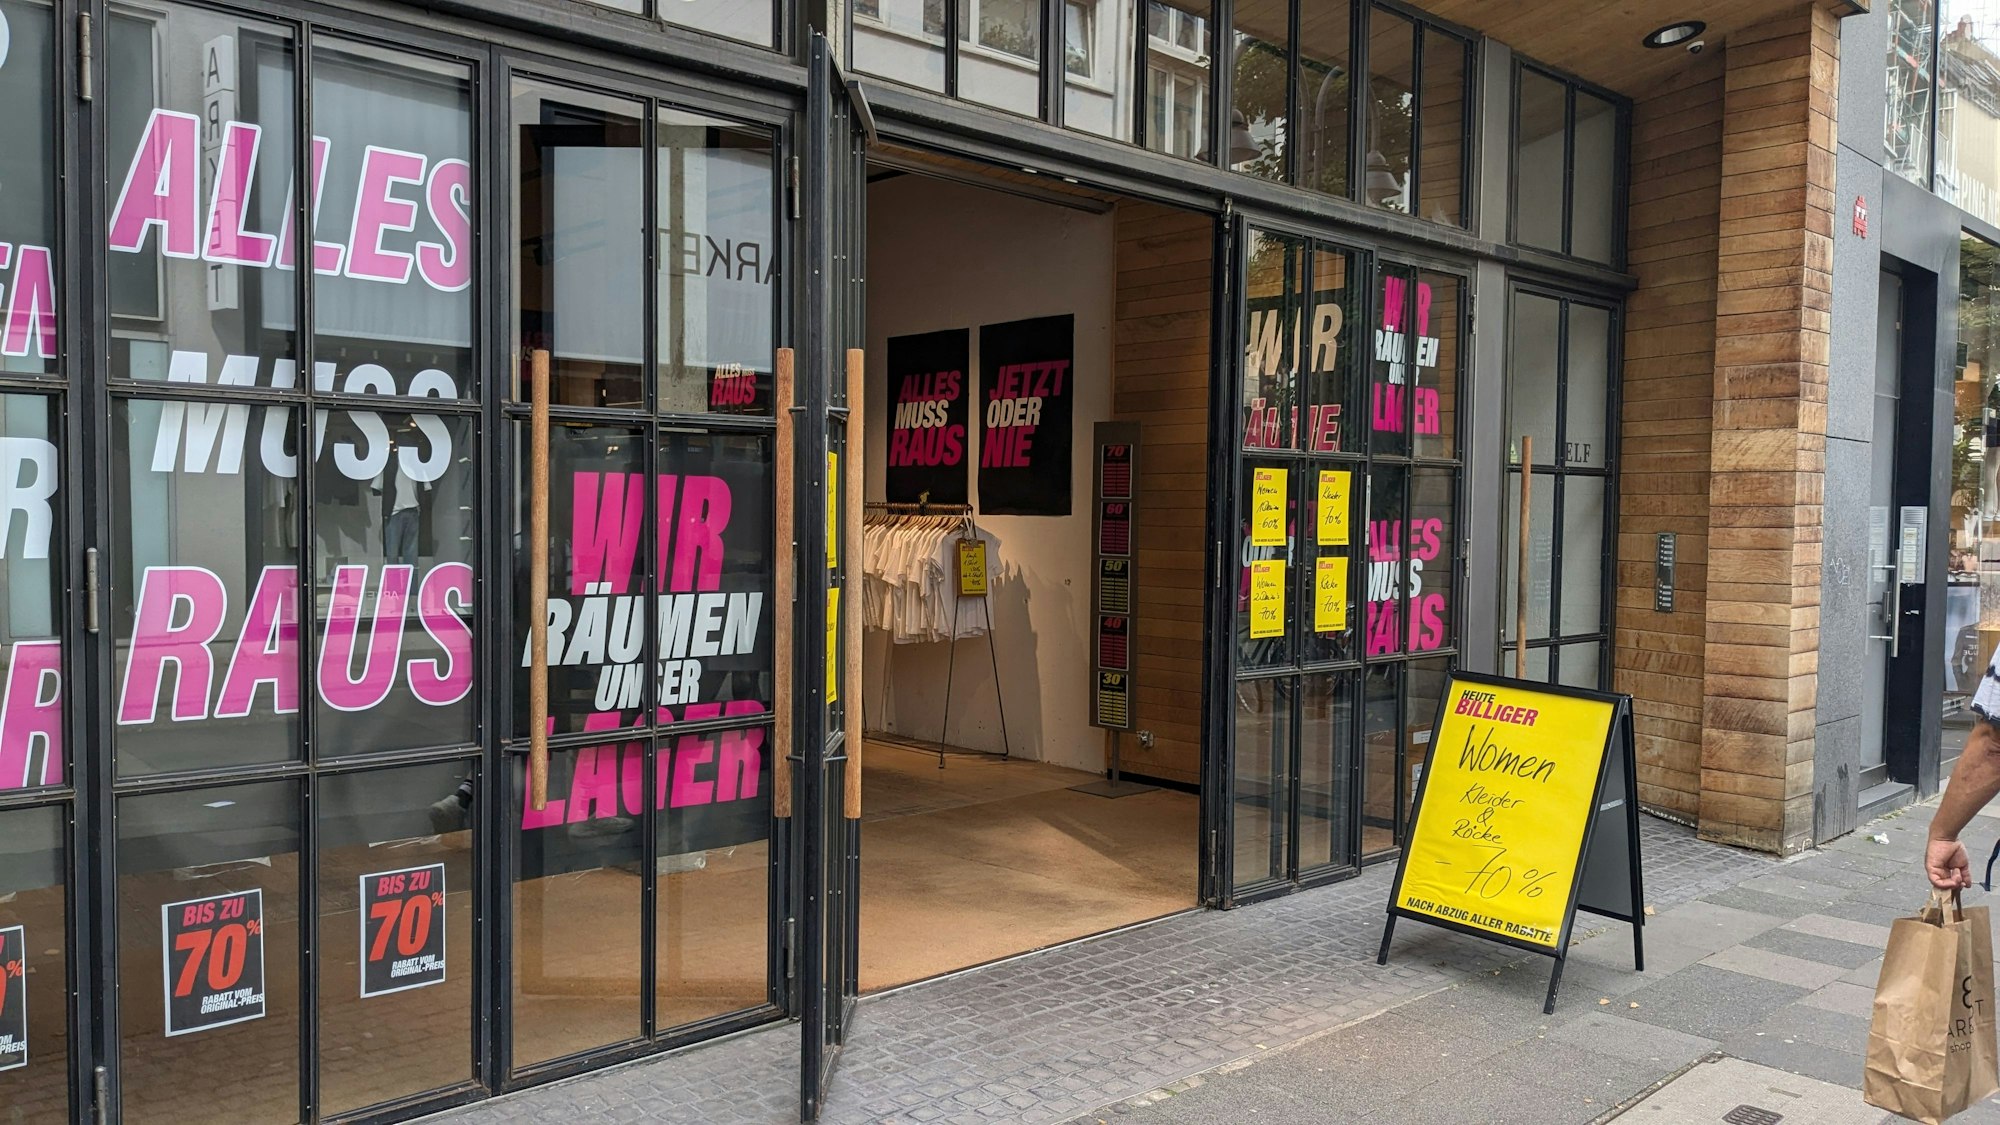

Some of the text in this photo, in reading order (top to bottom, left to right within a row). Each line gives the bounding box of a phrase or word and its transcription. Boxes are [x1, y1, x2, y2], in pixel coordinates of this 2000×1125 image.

[109, 108, 471, 293] ALLES
[1383, 275, 1432, 337] WR
[715, 363, 741, 380] ALLES
[899, 370, 962, 402] ALLES
[989, 359, 1070, 401] JETZT
[711, 375, 757, 406] RAUS
[151, 350, 458, 483] MUSS
[894, 399, 949, 431] MUSS
[986, 396, 1043, 429] ODER
[889, 424, 965, 467] RAUS
[982, 425, 1036, 469] NIE
[571, 471, 732, 596] WIR
[521, 581, 763, 668] RÄUMEN
[116, 561, 473, 725] RAUS
[1461, 689, 1496, 704] HEUTE
[1454, 699, 1539, 727] BILLIGER
[521, 699, 766, 830] LAGER
[1458, 724, 1556, 783] Women
[1459, 782, 1525, 809] Kleider
[1476, 806, 1495, 824] &
[1451, 819, 1504, 845] Röcke
[377, 871, 432, 896] BIS ZU
[183, 897, 245, 927] BIS ZU
[1406, 896, 1554, 943] NACH ABZUG ALLER RABATTE
[390, 959, 445, 978] ORIGINAL-PREIS
[391, 954, 435, 970] RABATT VOM
[200, 992, 264, 1014] ORIGINAL-PREIS
[202, 987, 253, 1006] RABATT VOM
